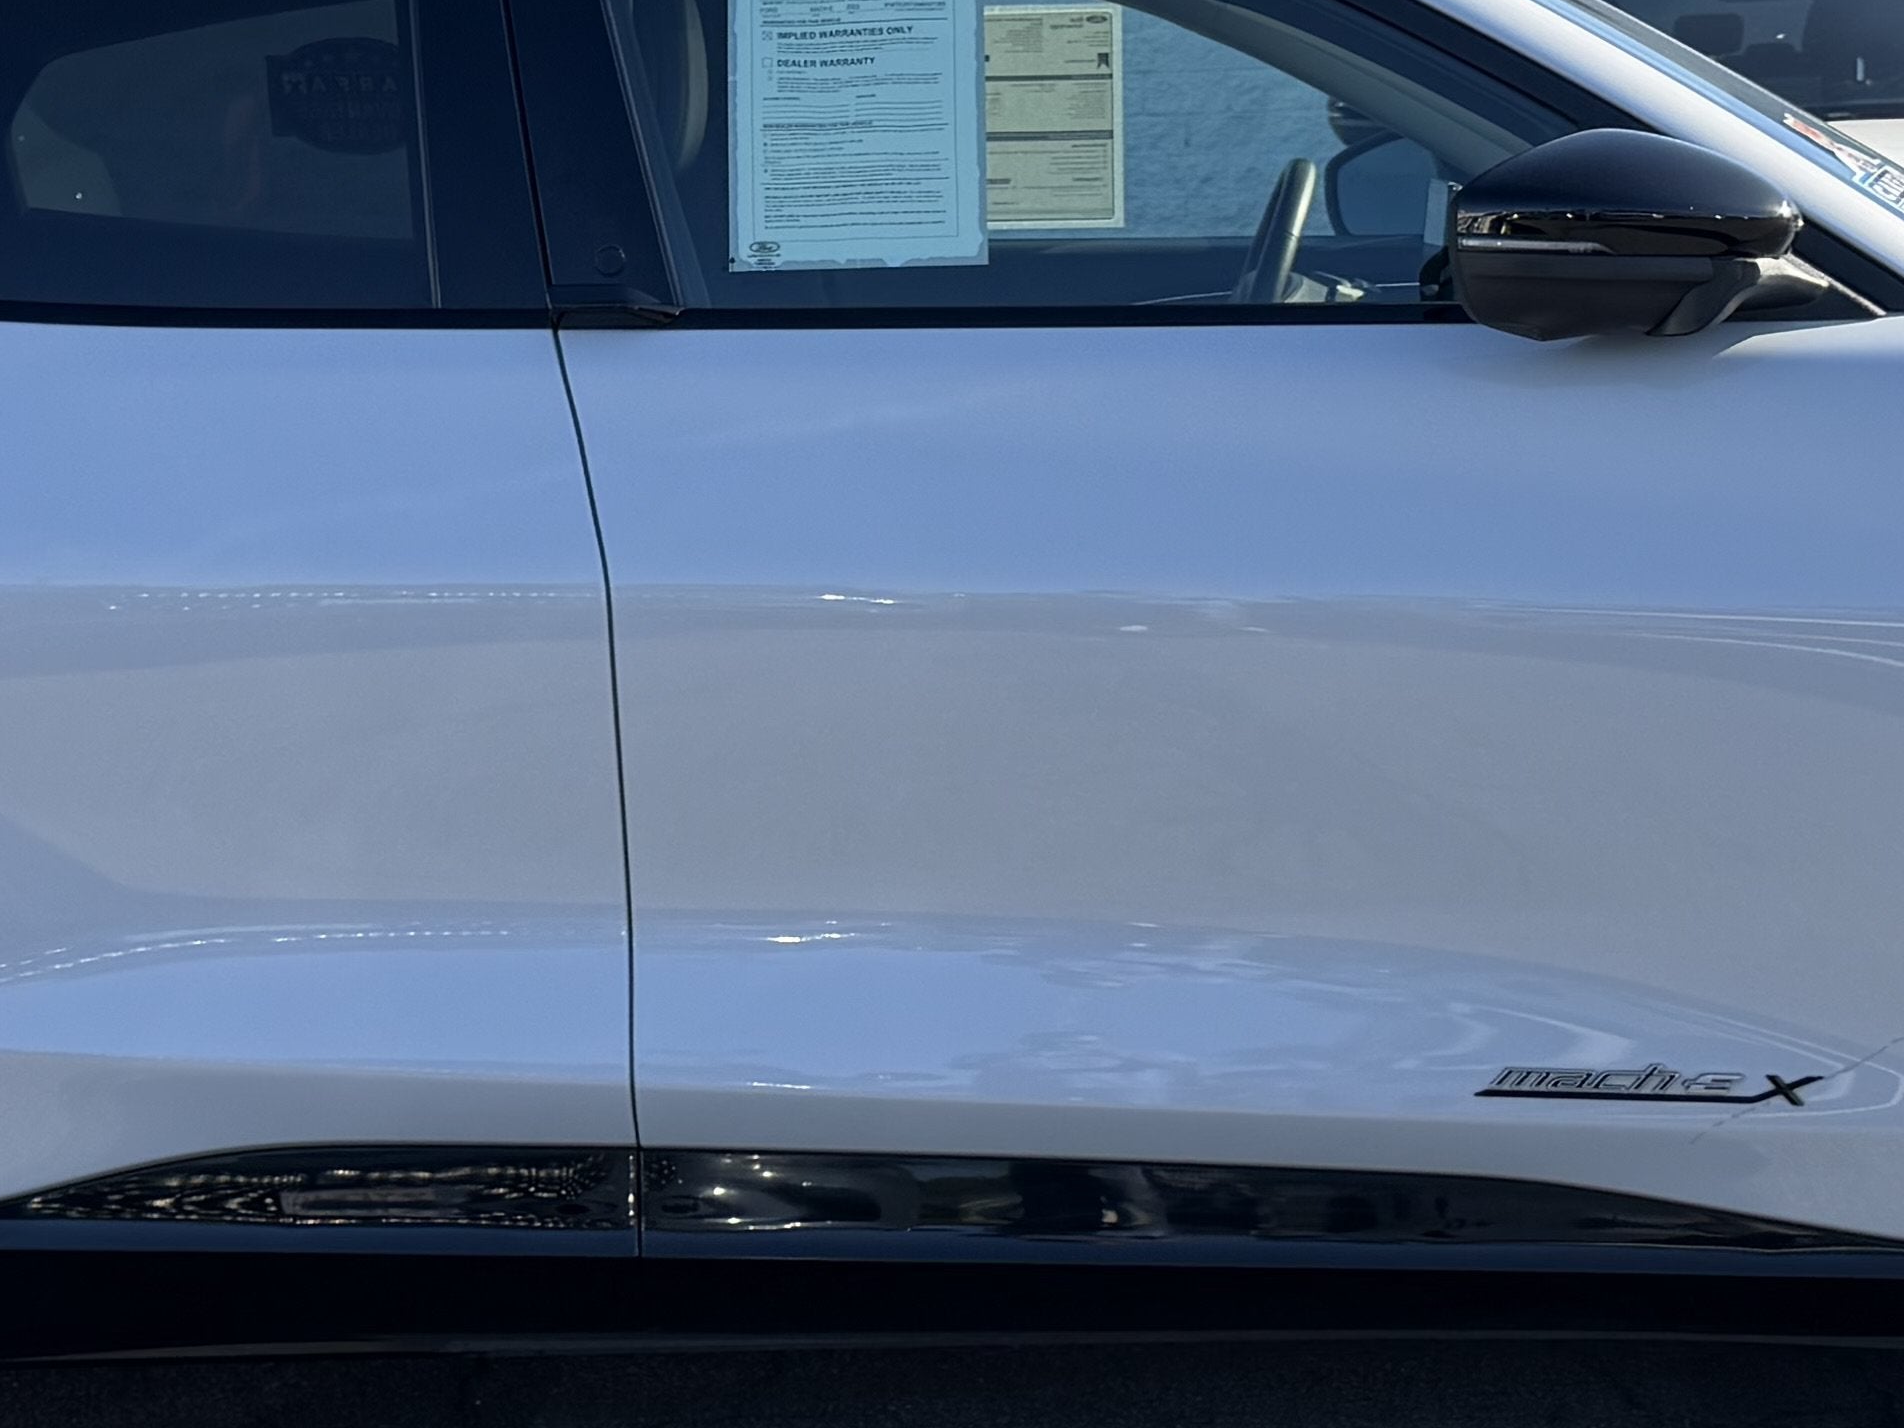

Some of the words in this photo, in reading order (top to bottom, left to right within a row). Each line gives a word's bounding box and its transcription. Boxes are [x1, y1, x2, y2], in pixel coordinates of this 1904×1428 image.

[777, 30, 816, 40] IMPLIED
[819, 28, 884, 39] WARRANTIES
[887, 25, 914, 35] ONLY
[777, 58, 817, 68] DEALER
[819, 57, 876, 68] WARRANTY
